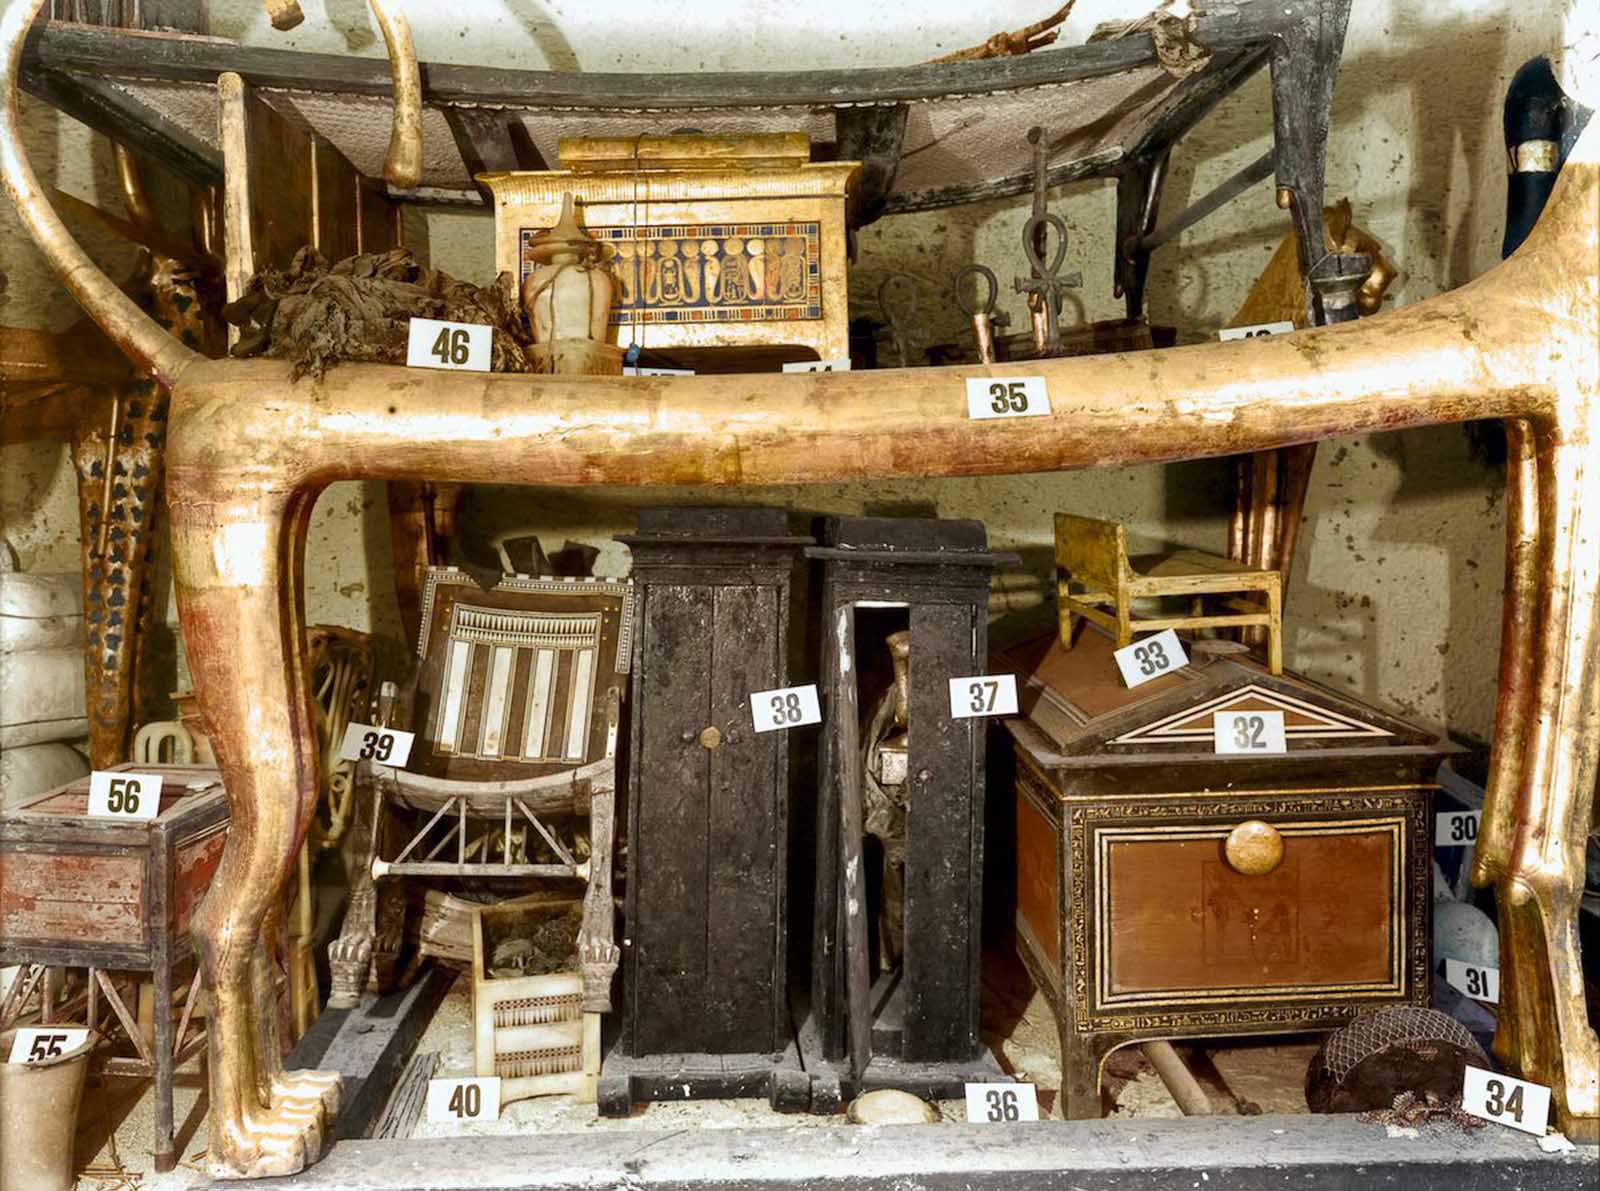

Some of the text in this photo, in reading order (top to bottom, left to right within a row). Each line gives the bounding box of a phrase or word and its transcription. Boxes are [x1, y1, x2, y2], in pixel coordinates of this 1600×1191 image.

[432, 328, 469, 364] 46
[990, 382, 1028, 413] 35
[1135, 641, 1169, 676] 33
[771, 693, 802, 725] 38
[969, 681, 999, 712] 37
[360, 734, 394, 761] 39
[1233, 716, 1266, 748] 32
[108, 779, 141, 813] 56
[1451, 815, 1477, 841] 30
[1467, 968, 1488, 998] 31
[448, 1084, 481, 1117] 40
[986, 1090, 1019, 1122] 36
[1486, 1079, 1524, 1123] 34
